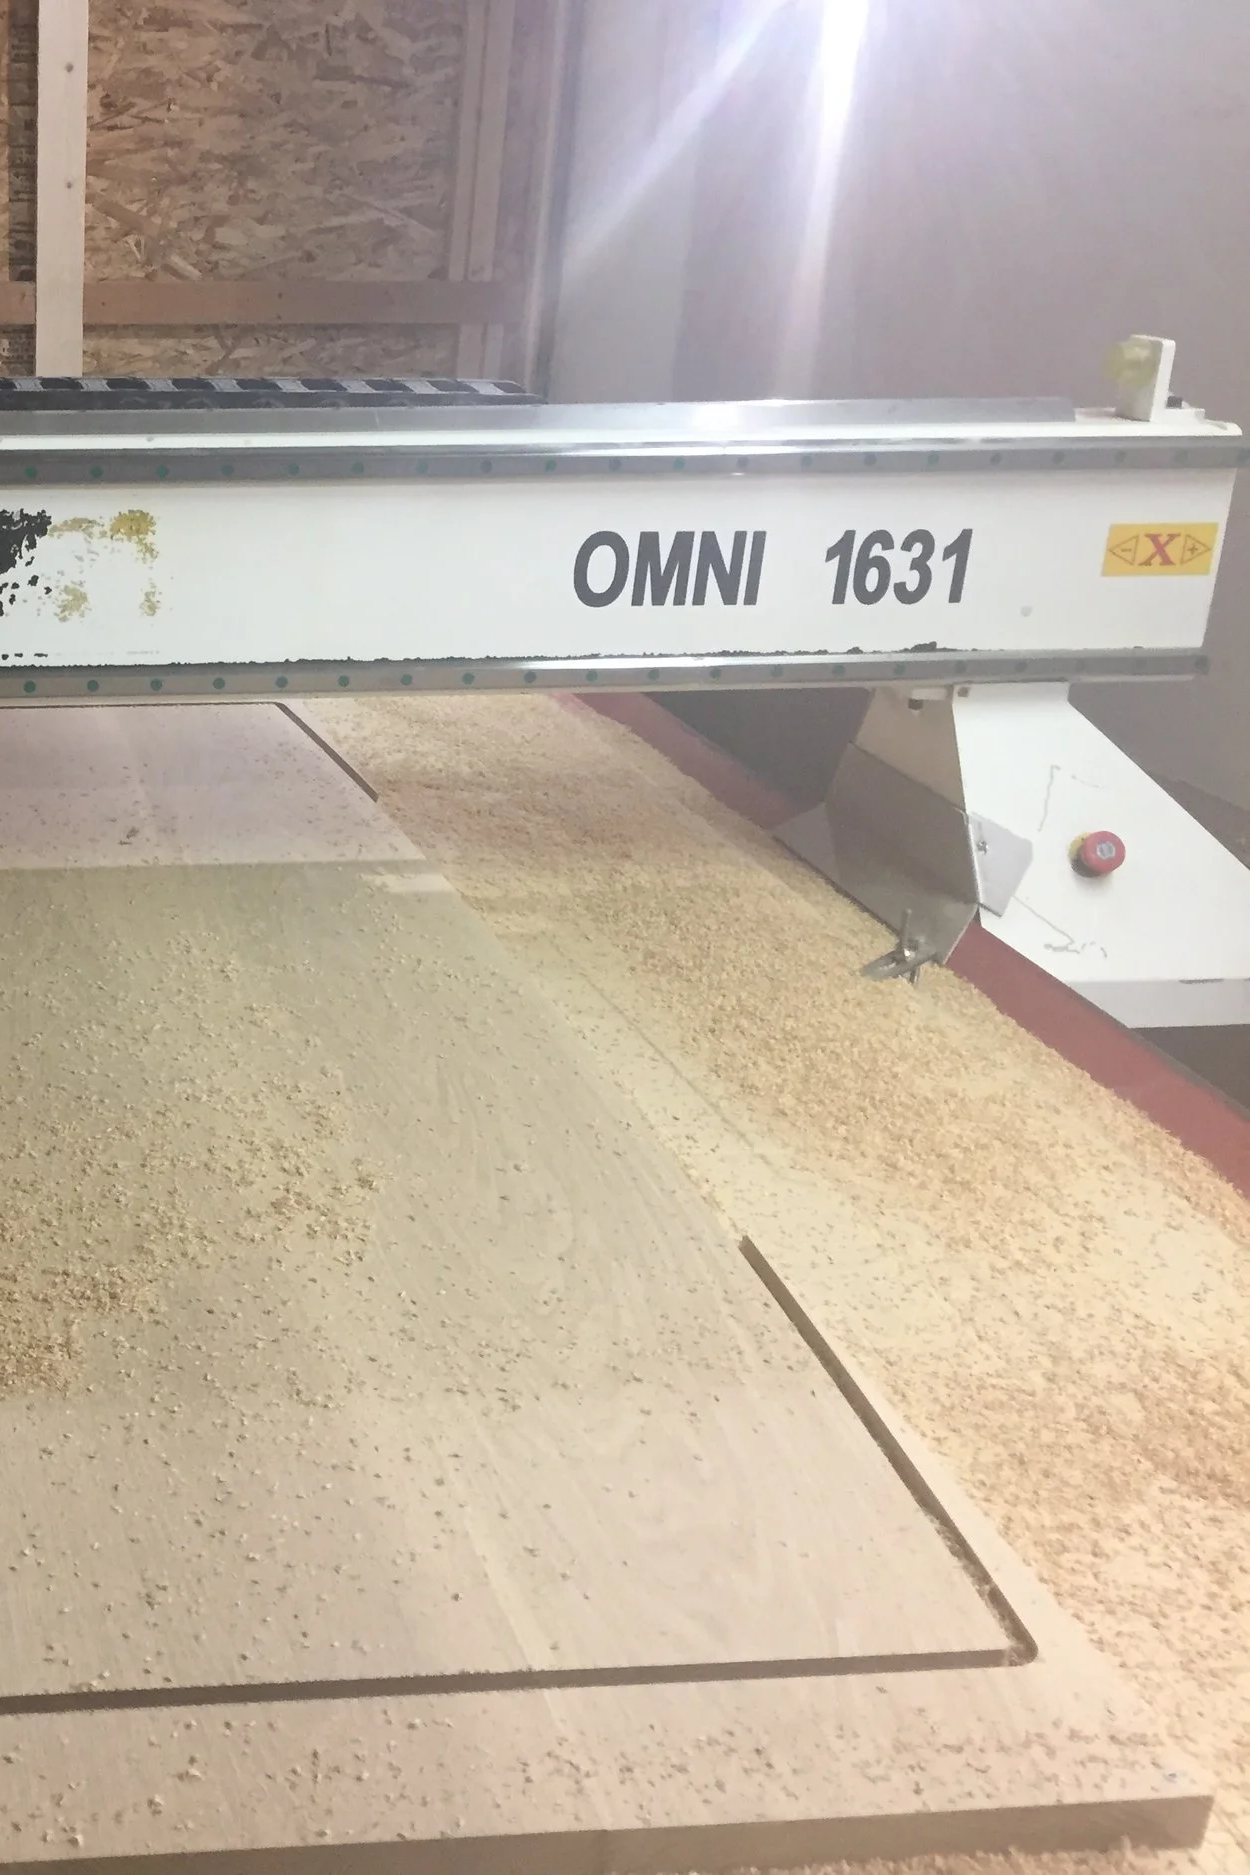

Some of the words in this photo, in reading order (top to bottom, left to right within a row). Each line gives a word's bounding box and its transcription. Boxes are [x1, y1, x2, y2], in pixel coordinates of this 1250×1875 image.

[573, 531, 767, 607] OMNI
[824, 529, 973, 605] 1631
[1138, 533, 1181, 566] X
